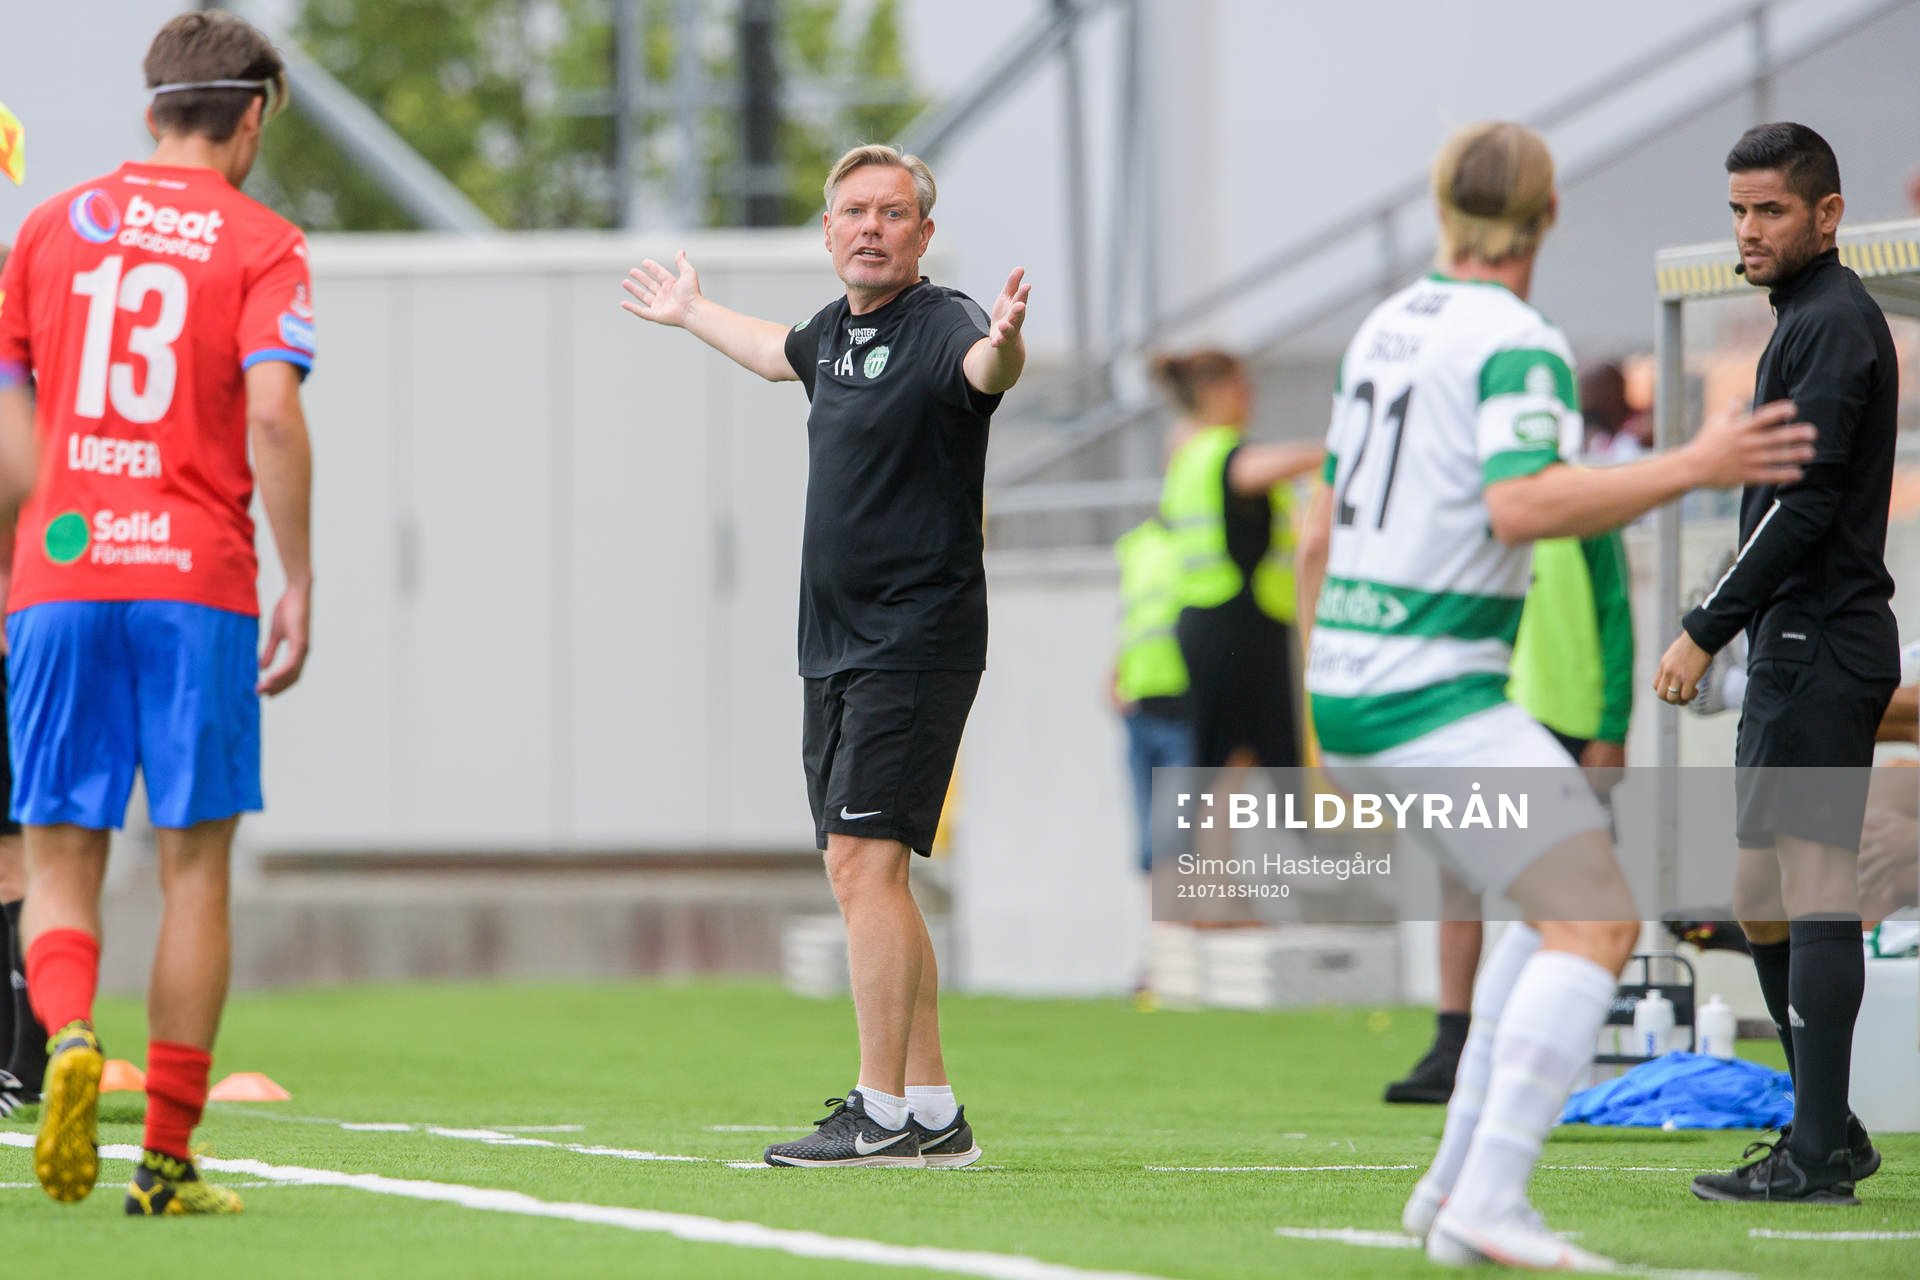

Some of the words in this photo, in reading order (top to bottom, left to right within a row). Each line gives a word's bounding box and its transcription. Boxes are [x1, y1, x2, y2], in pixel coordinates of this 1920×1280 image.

[124, 194, 224, 244] beat
[118, 227, 213, 262] diabetes
[71, 255, 189, 424] 13
[68, 432, 162, 479] LOEPER
[1337, 381, 1413, 530] 21
[93, 509, 170, 542] Solid
